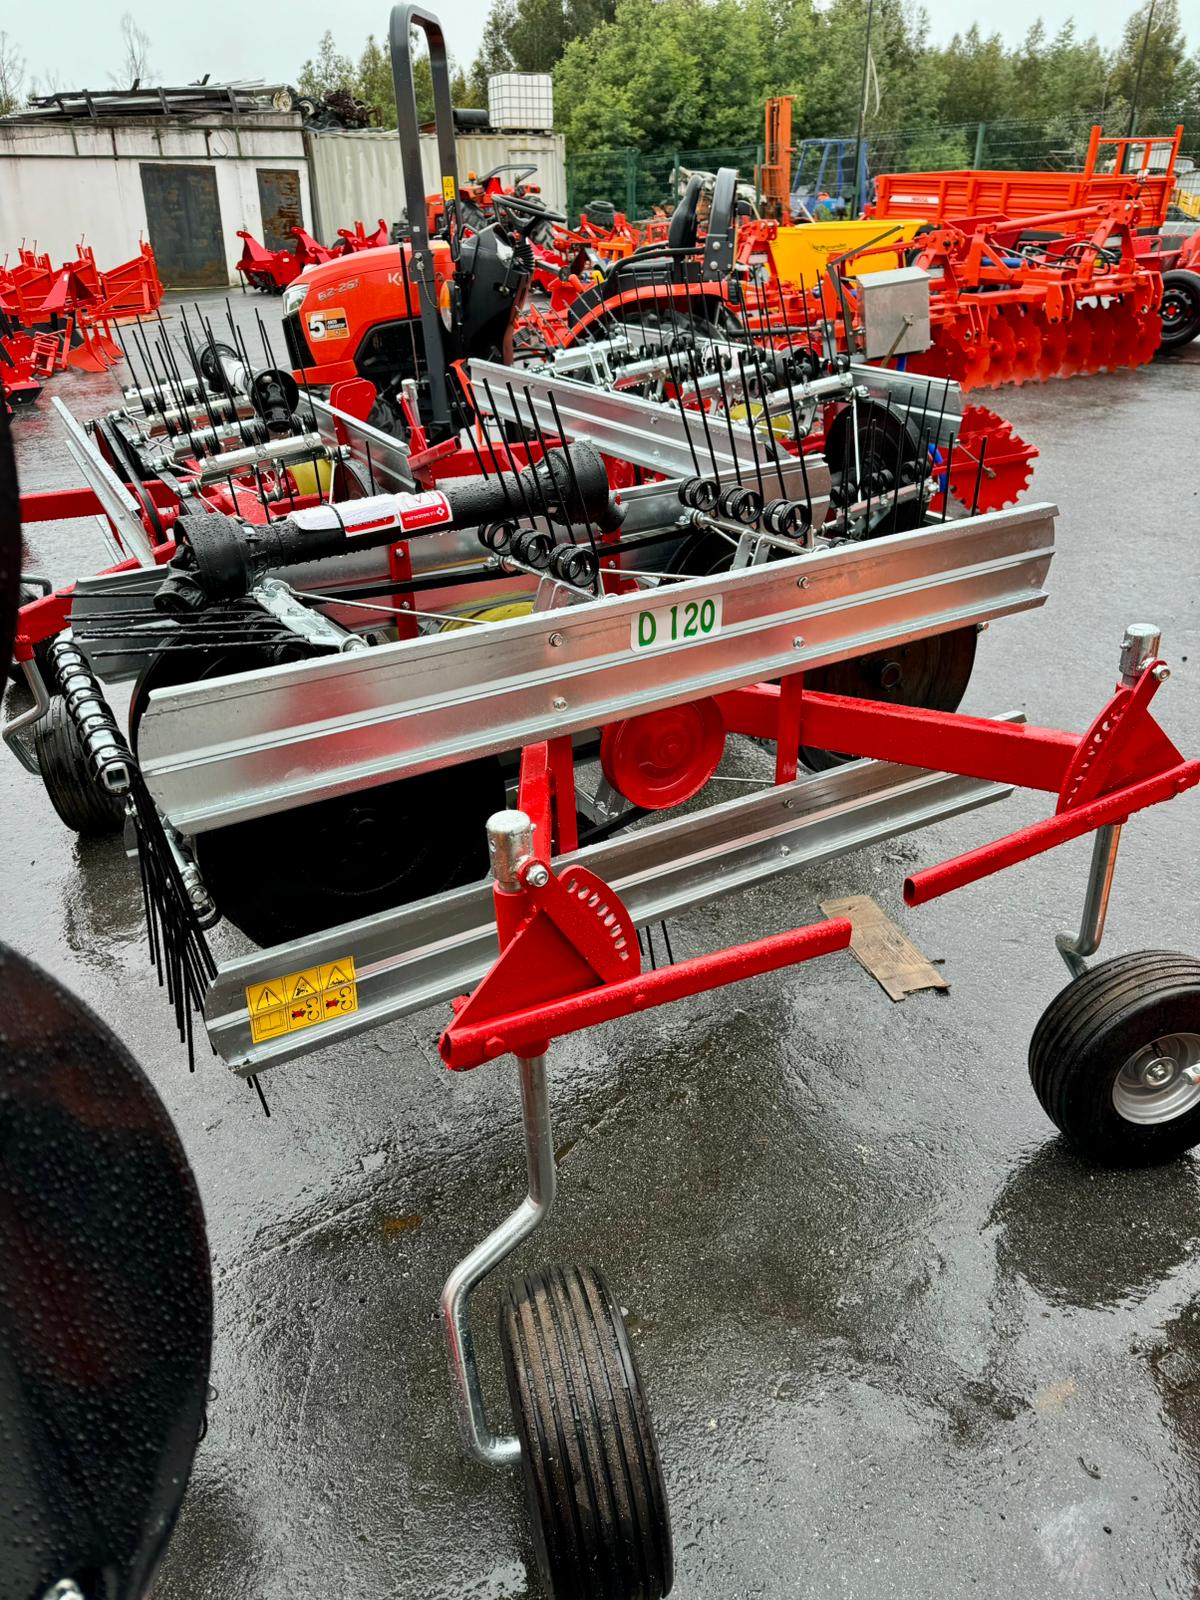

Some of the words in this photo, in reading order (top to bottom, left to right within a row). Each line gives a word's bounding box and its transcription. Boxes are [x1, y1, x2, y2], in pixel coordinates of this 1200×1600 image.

[310, 313, 325, 338] 5
[638, 611, 656, 647] D
[670, 599, 715, 640] 120
